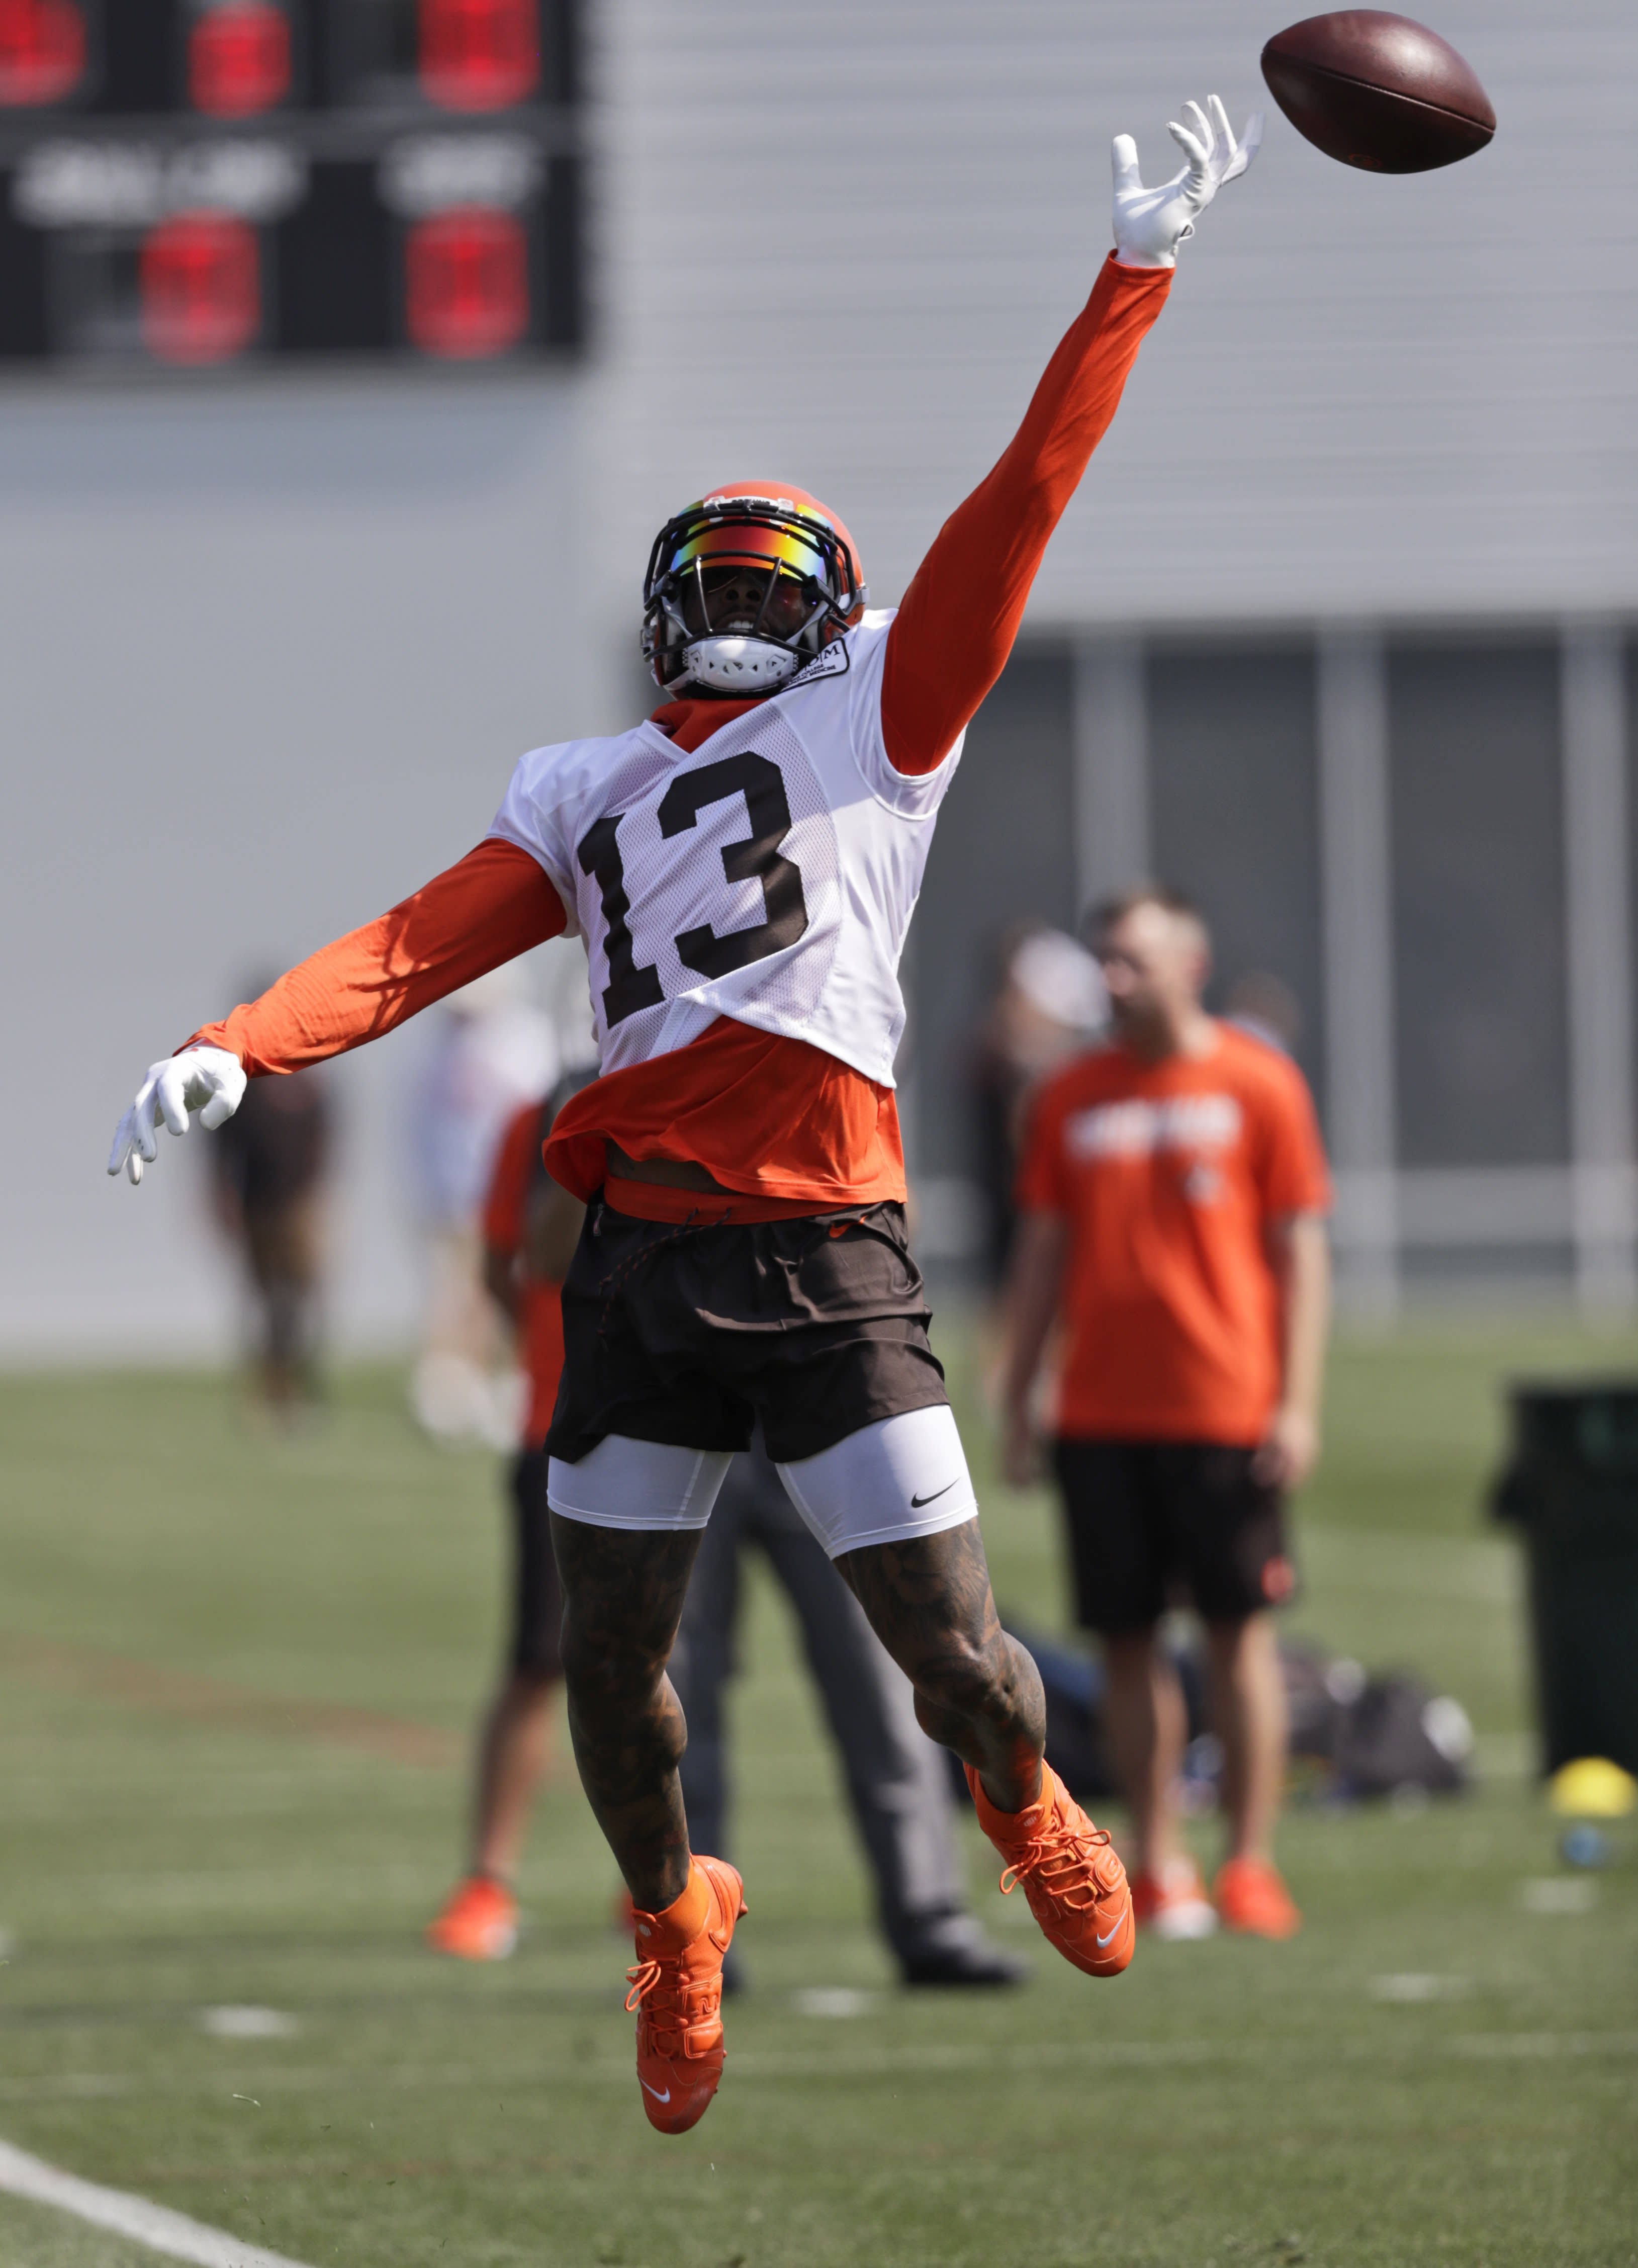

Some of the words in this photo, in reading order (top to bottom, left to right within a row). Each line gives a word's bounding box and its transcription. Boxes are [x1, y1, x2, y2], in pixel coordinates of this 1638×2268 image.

[801, 664, 824, 676] COLLEGE
[809, 665, 837, 677] MEDICINE
[577, 751, 808, 1029] 13
